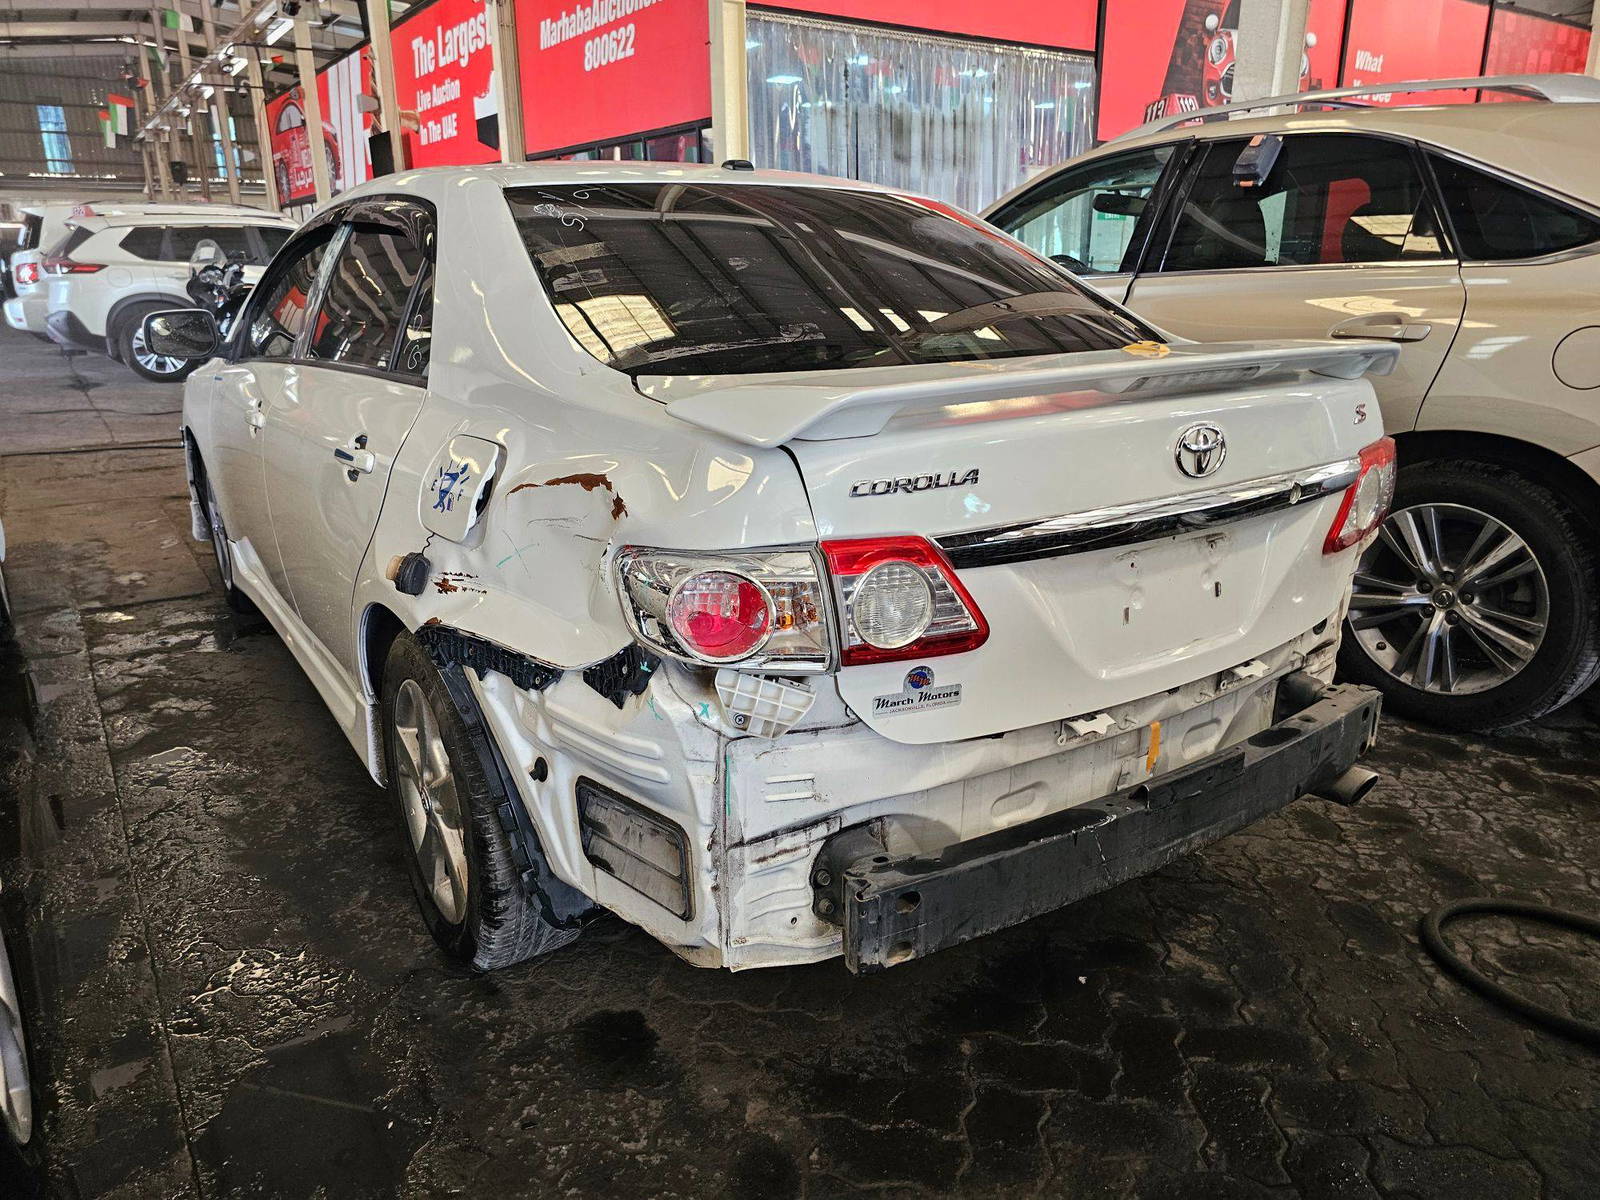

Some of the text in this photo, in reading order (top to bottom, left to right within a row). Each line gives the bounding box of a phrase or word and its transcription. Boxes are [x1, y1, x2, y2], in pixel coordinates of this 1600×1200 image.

[540, 0, 663, 50] MarhabaAuctio
[412, 12, 492, 79] The Largest
[584, 23, 635, 72] 800622
[1355, 50, 1384, 72] What
[416, 78, 461, 112] Live Auction
[420, 112, 458, 146] In The UAE
[1353, 403, 1367, 425] S
[849, 468, 980, 497] COROLLA
[875, 690, 960, 710] March Motors
